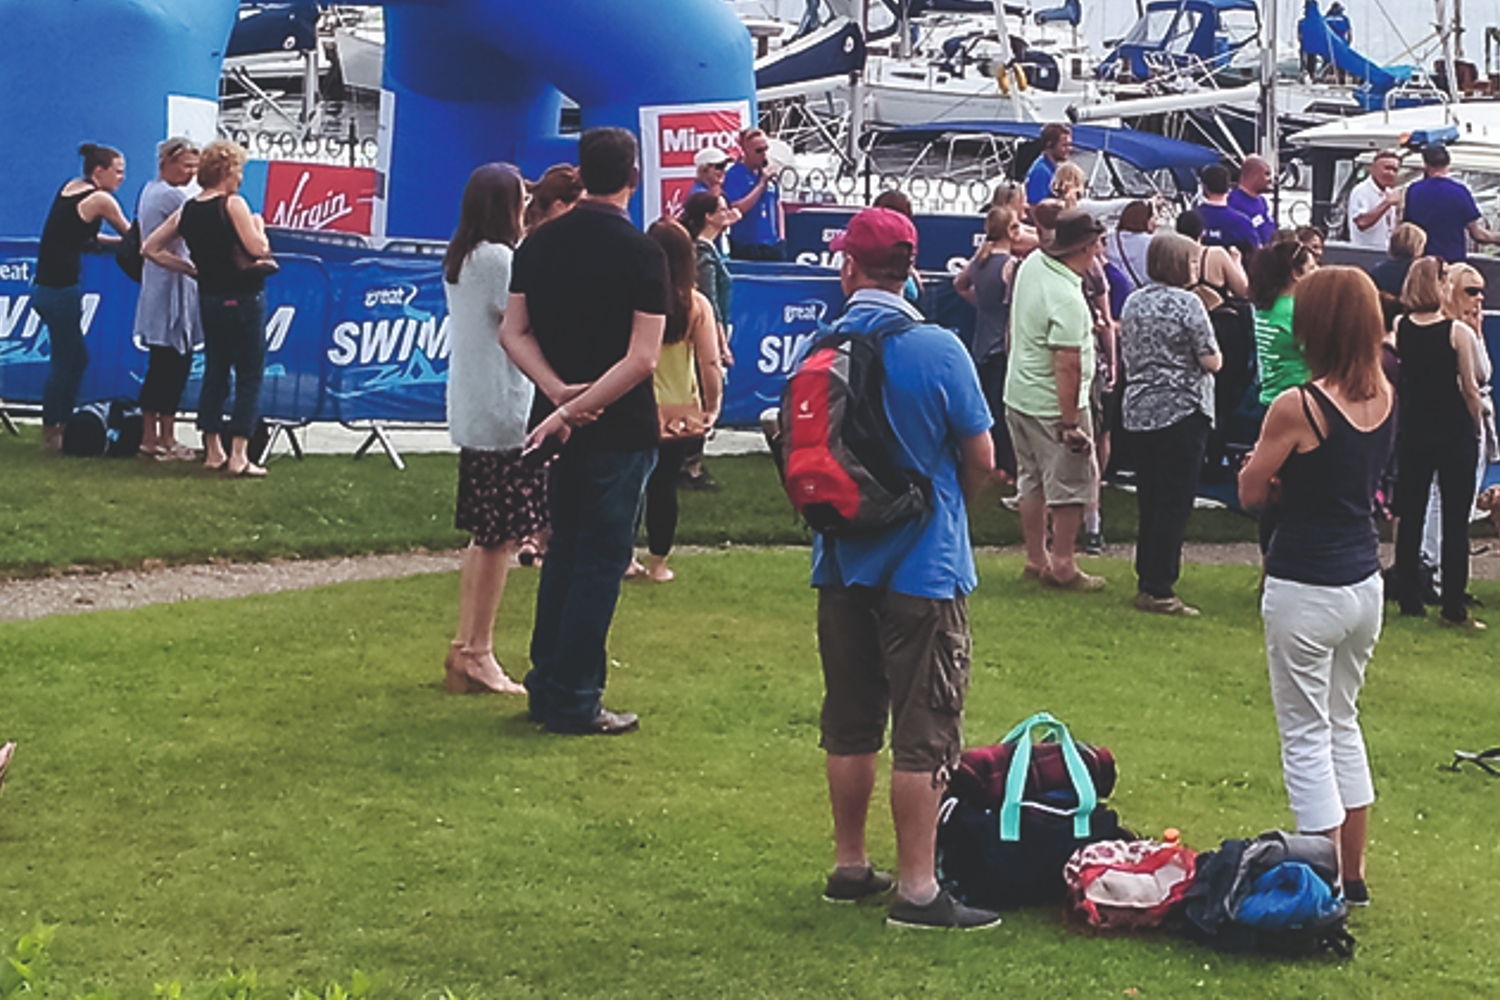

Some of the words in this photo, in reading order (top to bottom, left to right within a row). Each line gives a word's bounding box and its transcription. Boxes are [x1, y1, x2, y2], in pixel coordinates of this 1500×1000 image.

[272, 171, 352, 230] Virgin
[0, 262, 29, 281] eat
[364, 286, 404, 307] great
[784, 304, 816, 323] great
[327, 314, 451, 366] SWIM
